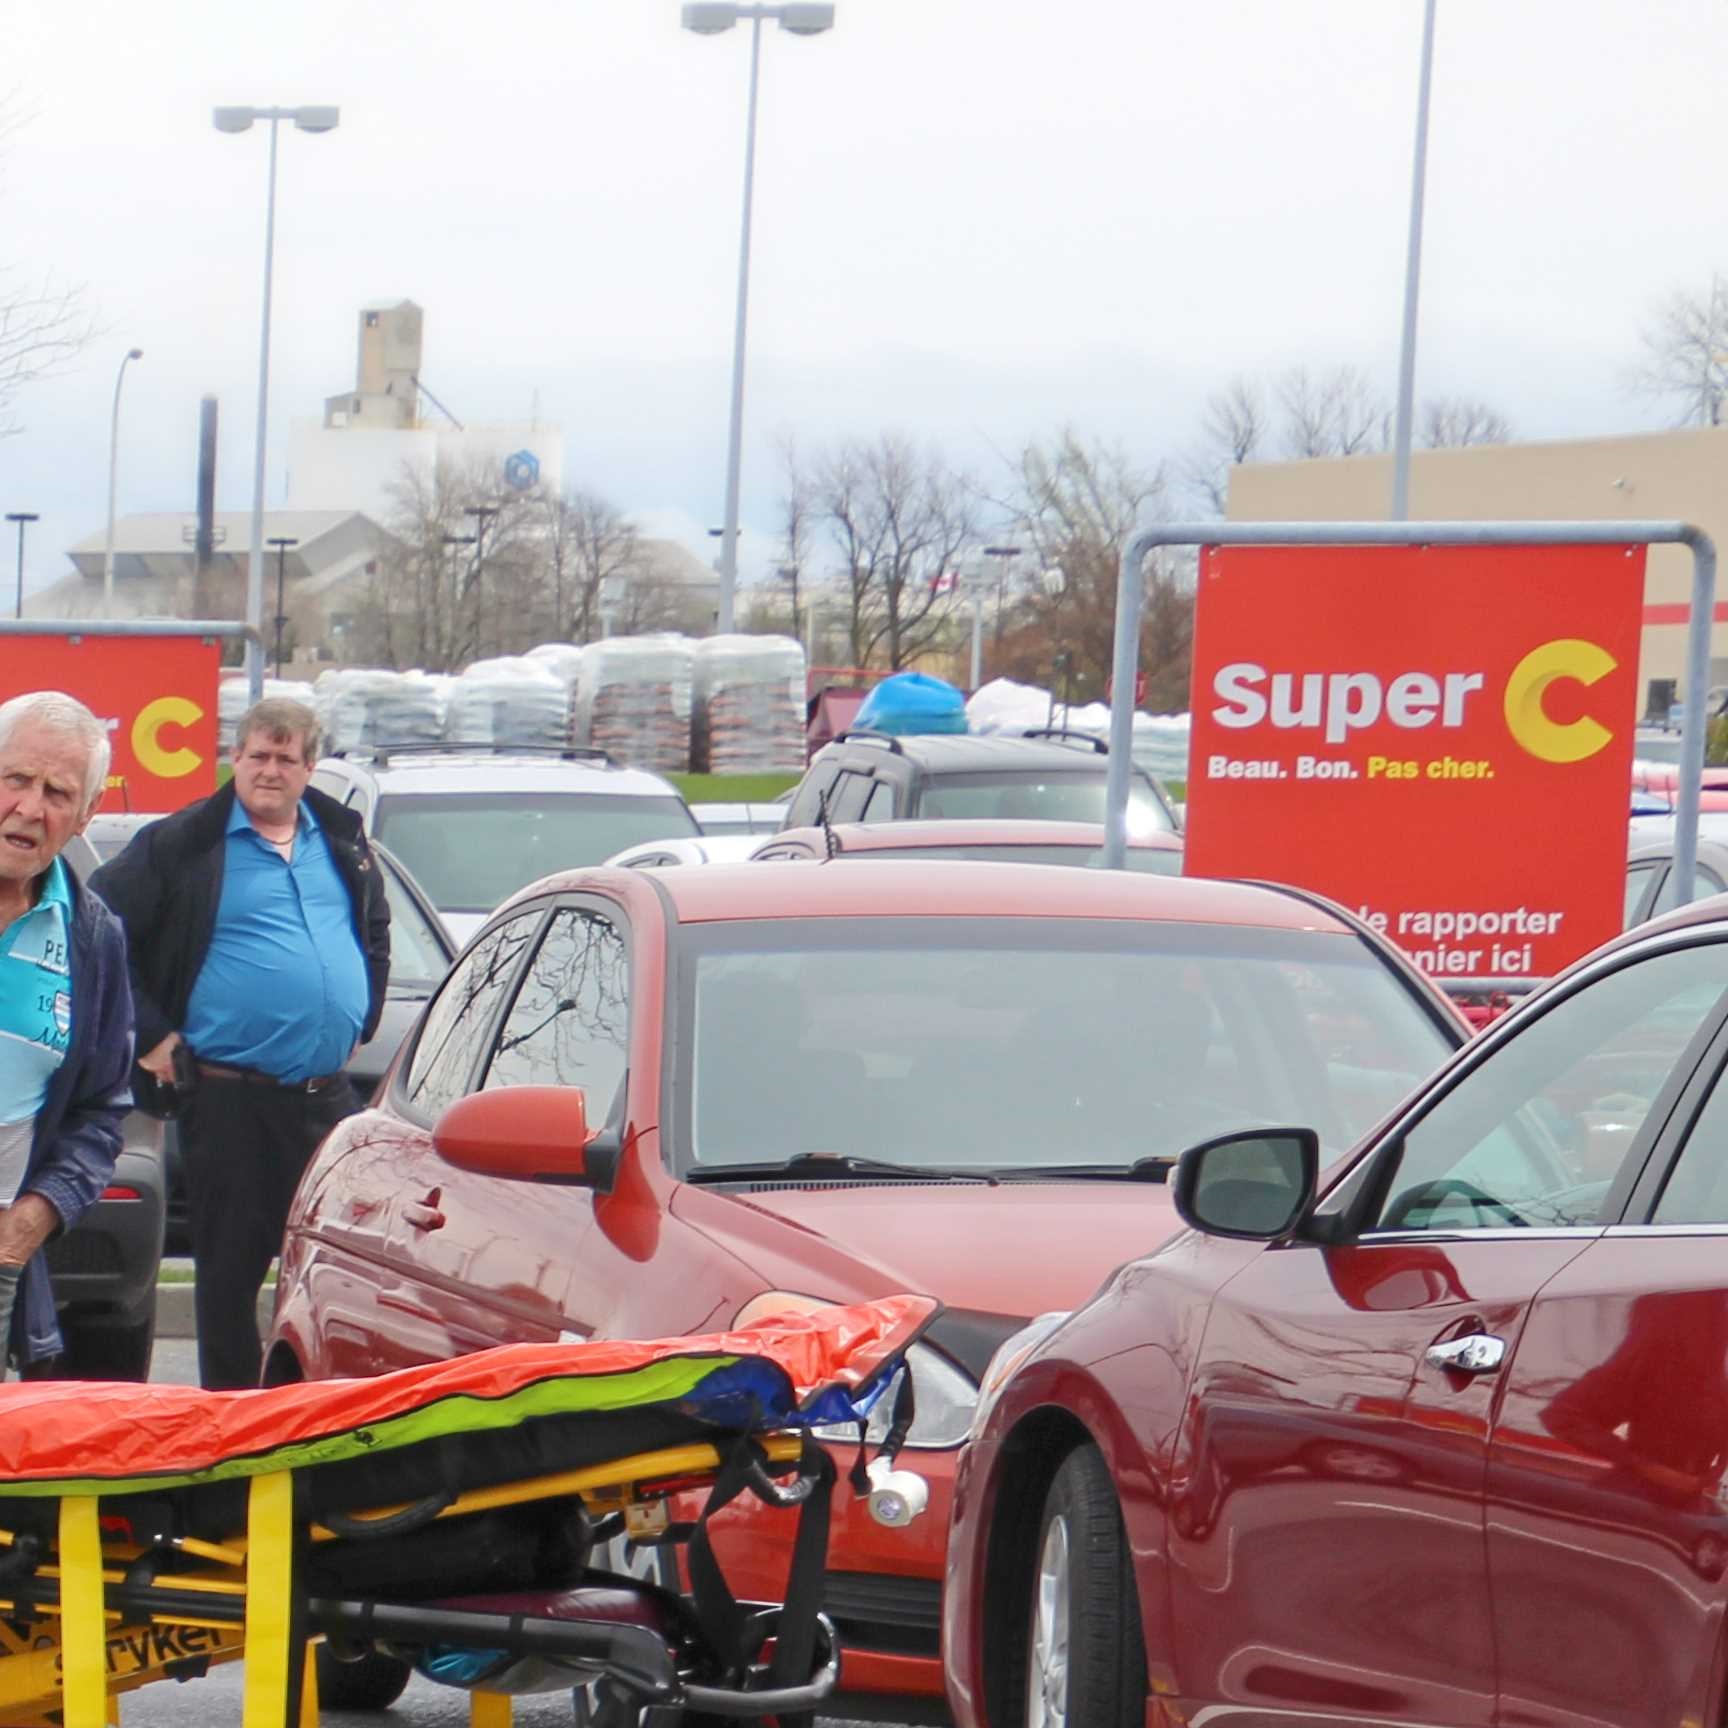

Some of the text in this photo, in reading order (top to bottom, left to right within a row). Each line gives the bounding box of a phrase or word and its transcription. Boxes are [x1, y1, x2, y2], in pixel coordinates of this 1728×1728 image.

[1211, 638, 1619, 763] Super C
[130, 696, 205, 779] C
[1207, 756, 1494, 780] Beau. Bon. Pas cher.
[1398, 906, 1564, 941] rapporter
[1402, 943, 1532, 972] nier ici
[55, 1624, 224, 1686] ryker
